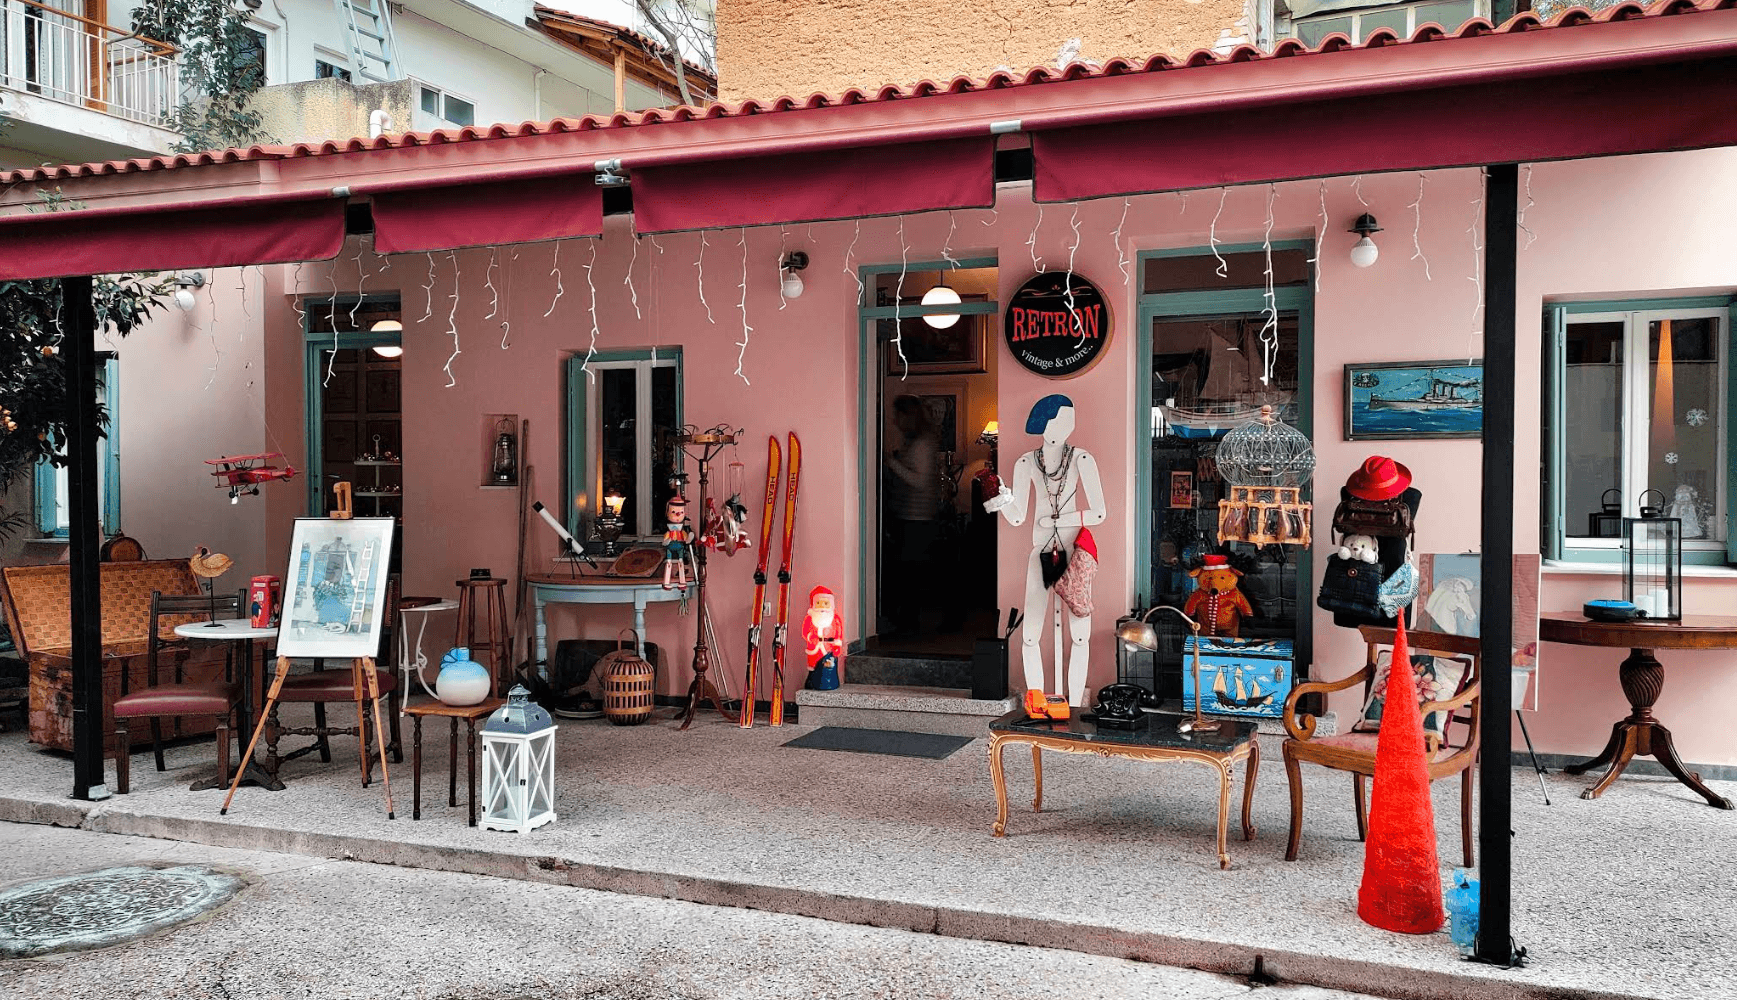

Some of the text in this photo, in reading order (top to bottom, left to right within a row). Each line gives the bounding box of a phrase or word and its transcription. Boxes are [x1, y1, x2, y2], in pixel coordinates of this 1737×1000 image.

[1012, 304, 1100, 342] RETRON
[1021, 350, 1054, 370] vintage
[1055, 358, 1064, 368] &
[768, 476, 776, 504] HEAD
